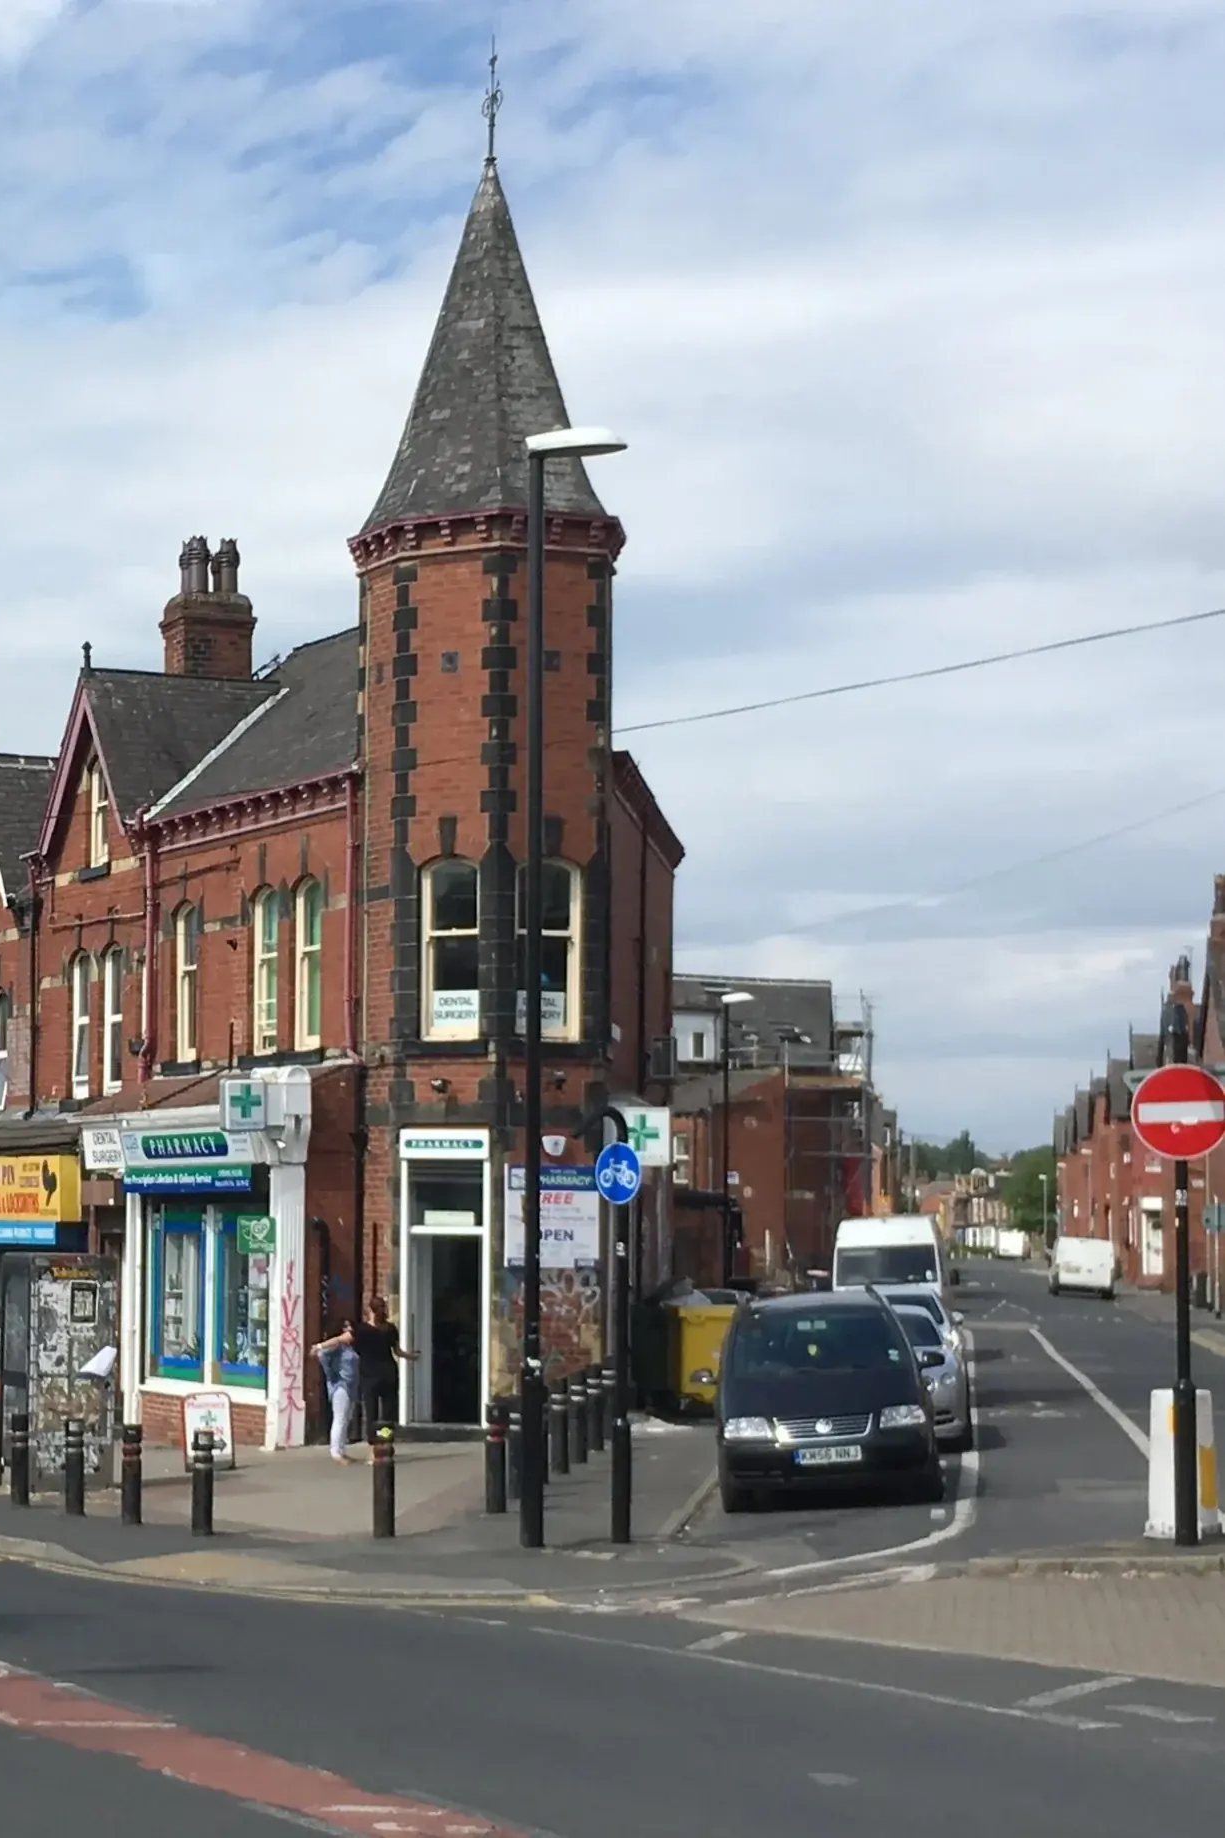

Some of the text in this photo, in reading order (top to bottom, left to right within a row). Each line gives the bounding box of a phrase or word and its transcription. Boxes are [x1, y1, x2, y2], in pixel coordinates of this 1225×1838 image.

[438, 996, 474, 1007] DENTAL
[435, 1010, 477, 1020] SURGERY
[92, 1131, 117, 1146] DENTAL
[411, 1140, 474, 1149] PHARMACY
[148, 1135, 217, 1156] PHARMACY
[92, 1149, 121, 1164] SURGERY
[541, 1192, 575, 1205] REE
